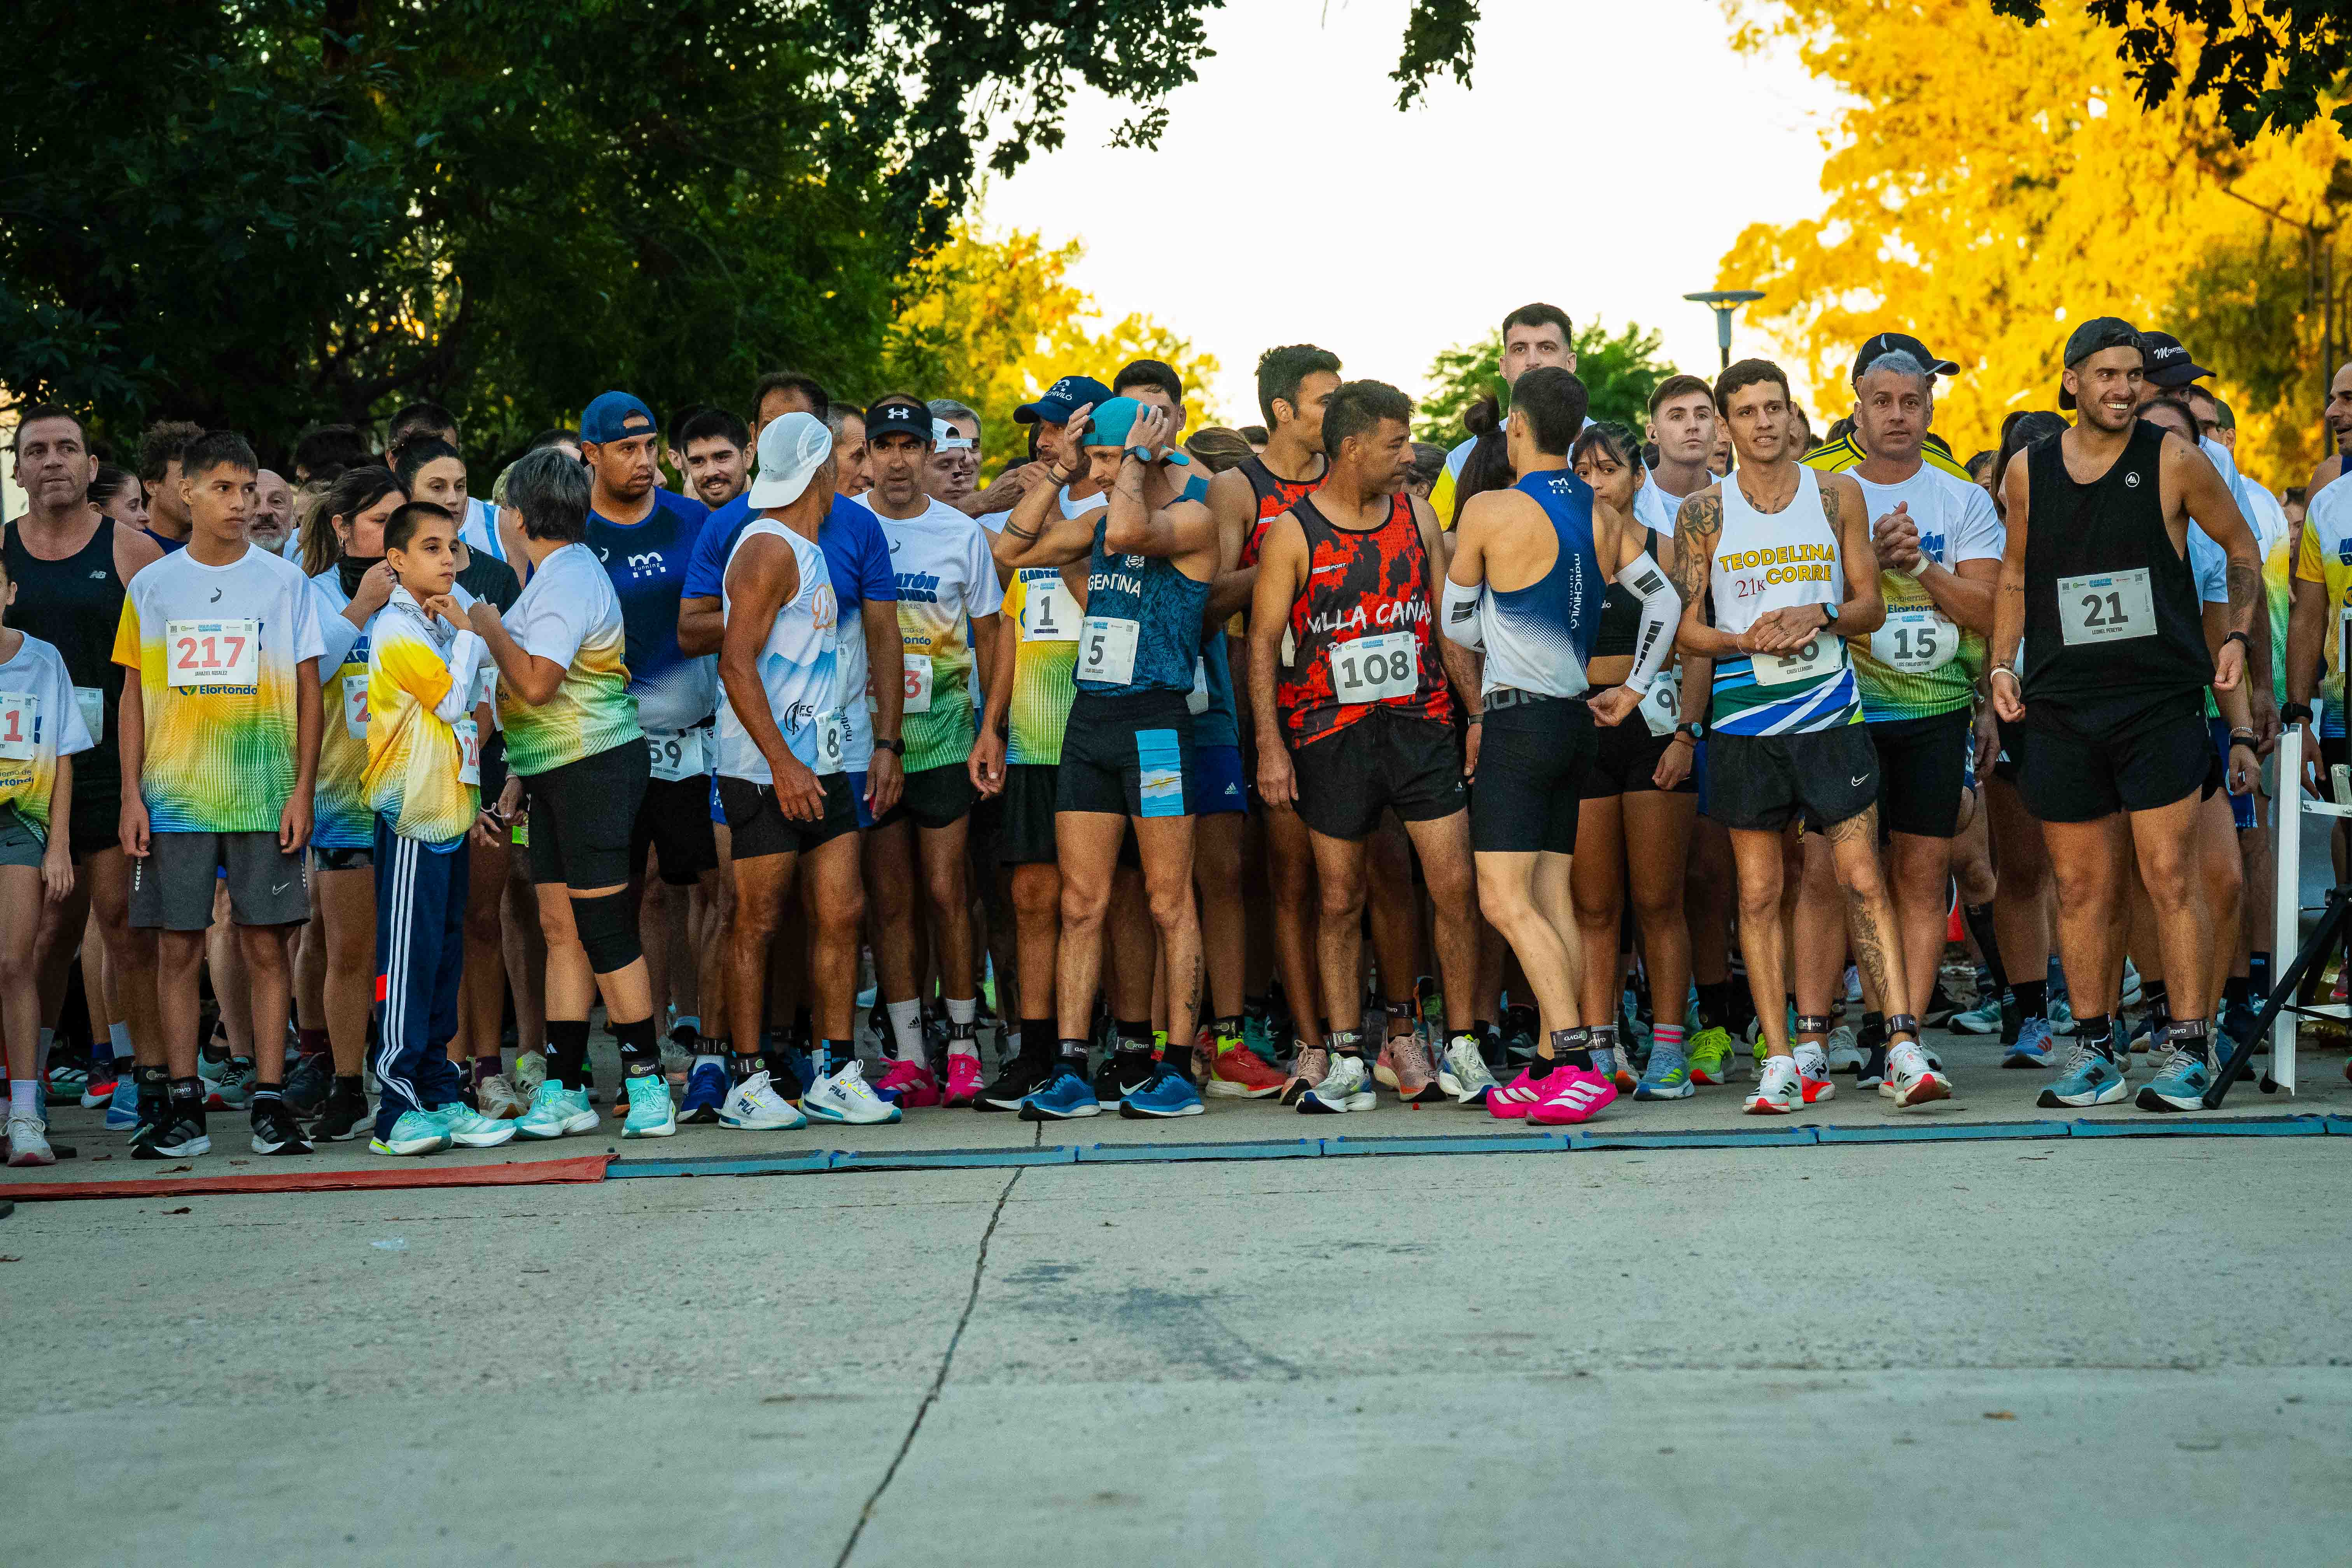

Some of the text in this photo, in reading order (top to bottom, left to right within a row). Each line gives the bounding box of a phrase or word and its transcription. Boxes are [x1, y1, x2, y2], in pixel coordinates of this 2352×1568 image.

[634, 562, 660, 571] running
[1718, 544, 1836, 573] TEODELINA
[1766, 564, 1832, 585] CORRE
[1040, 596, 1054, 626] 1
[2081, 591, 2129, 627] 21
[177, 637, 245, 669] 217
[1088, 635, 1105, 665] 5
[1894, 628, 1937, 659] 15
[1341, 650, 1410, 688] 108
[200, 684, 257, 695] Elortondo
[4, 710, 23, 742] 1
[738, 1098, 756, 1116] FILA
[829, 1085, 847, 1101] FILA
